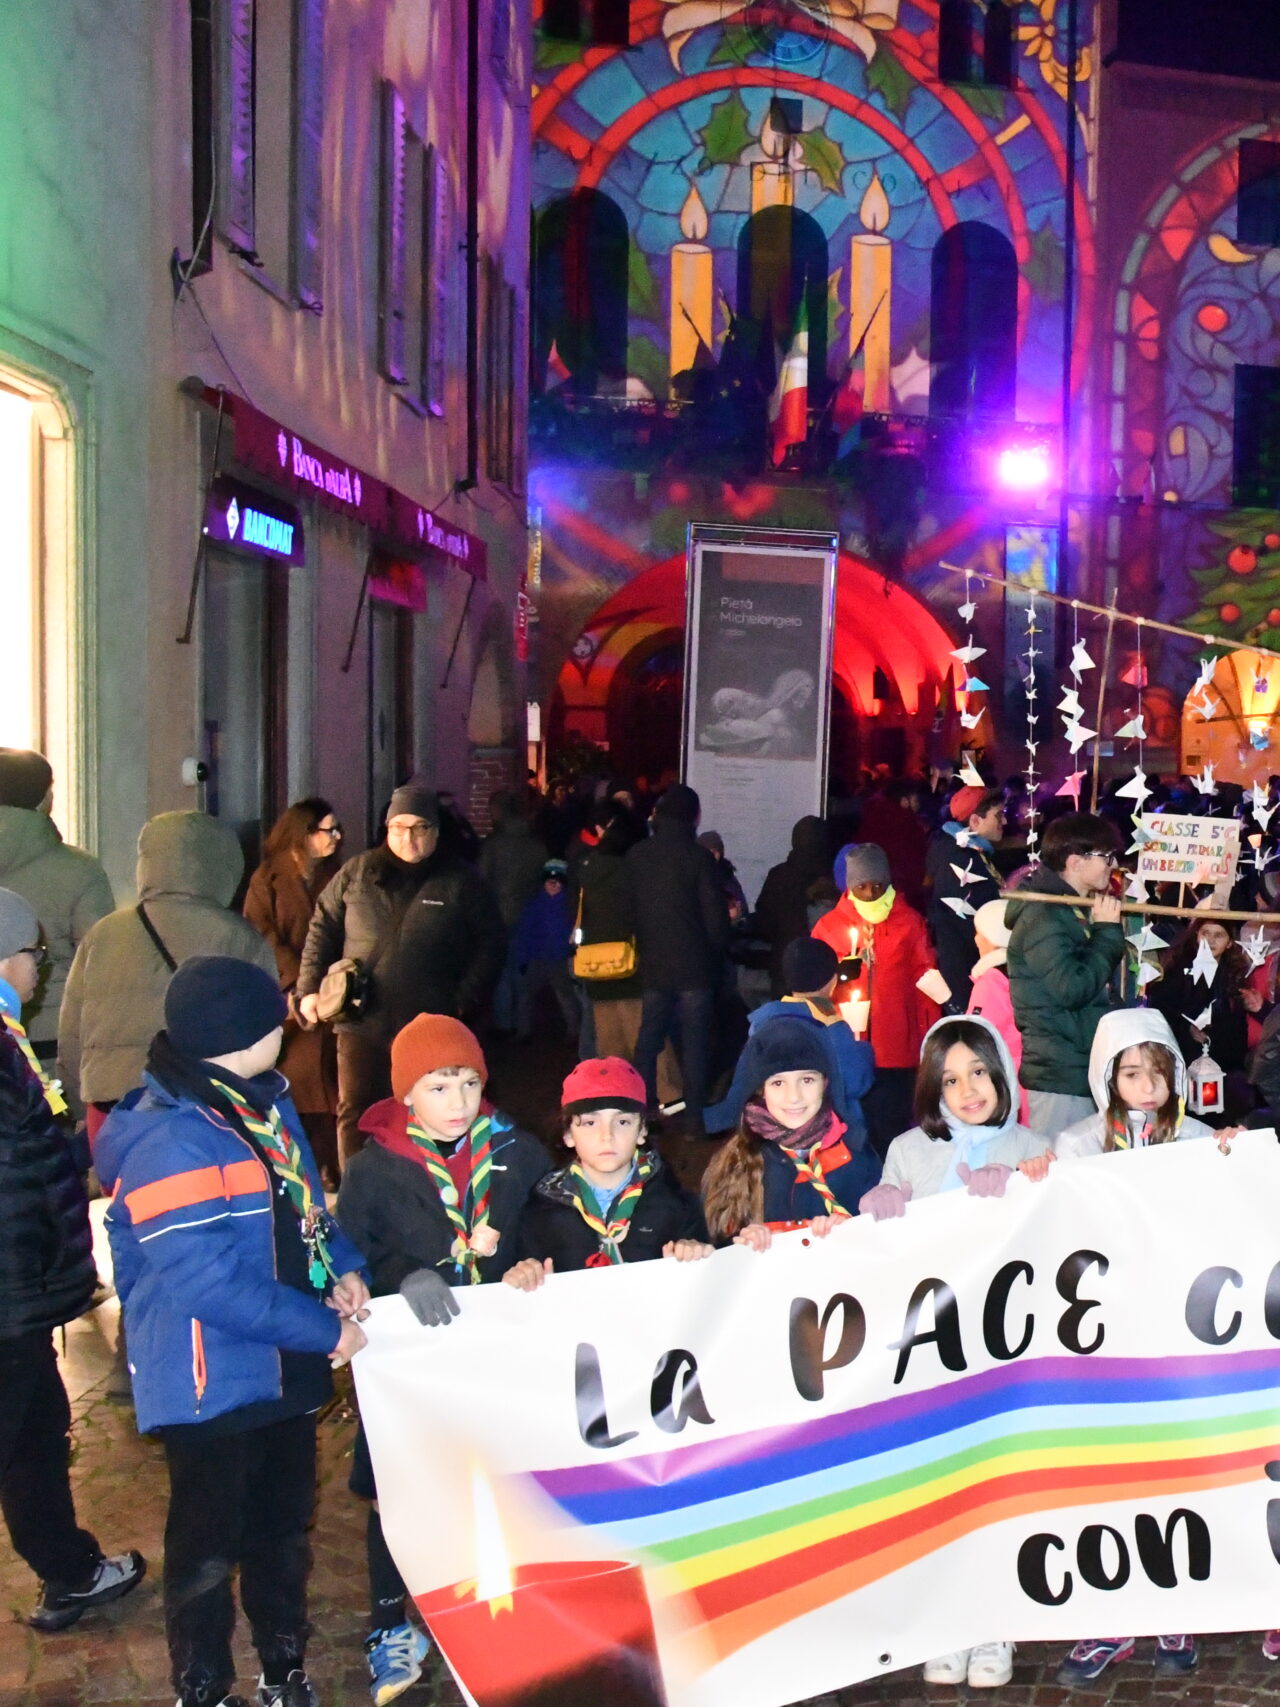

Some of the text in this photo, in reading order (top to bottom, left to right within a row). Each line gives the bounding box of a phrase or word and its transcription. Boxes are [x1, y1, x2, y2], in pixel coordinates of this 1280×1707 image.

[242, 507, 294, 556] BANCOMAT
[719, 611, 803, 629] Michelangelo
[1150, 820, 1200, 838] CLASSE
[1143, 840, 1180, 855] SCUOLA
[574, 1341, 716, 1450] La
[1016, 1507, 1212, 1607] con
